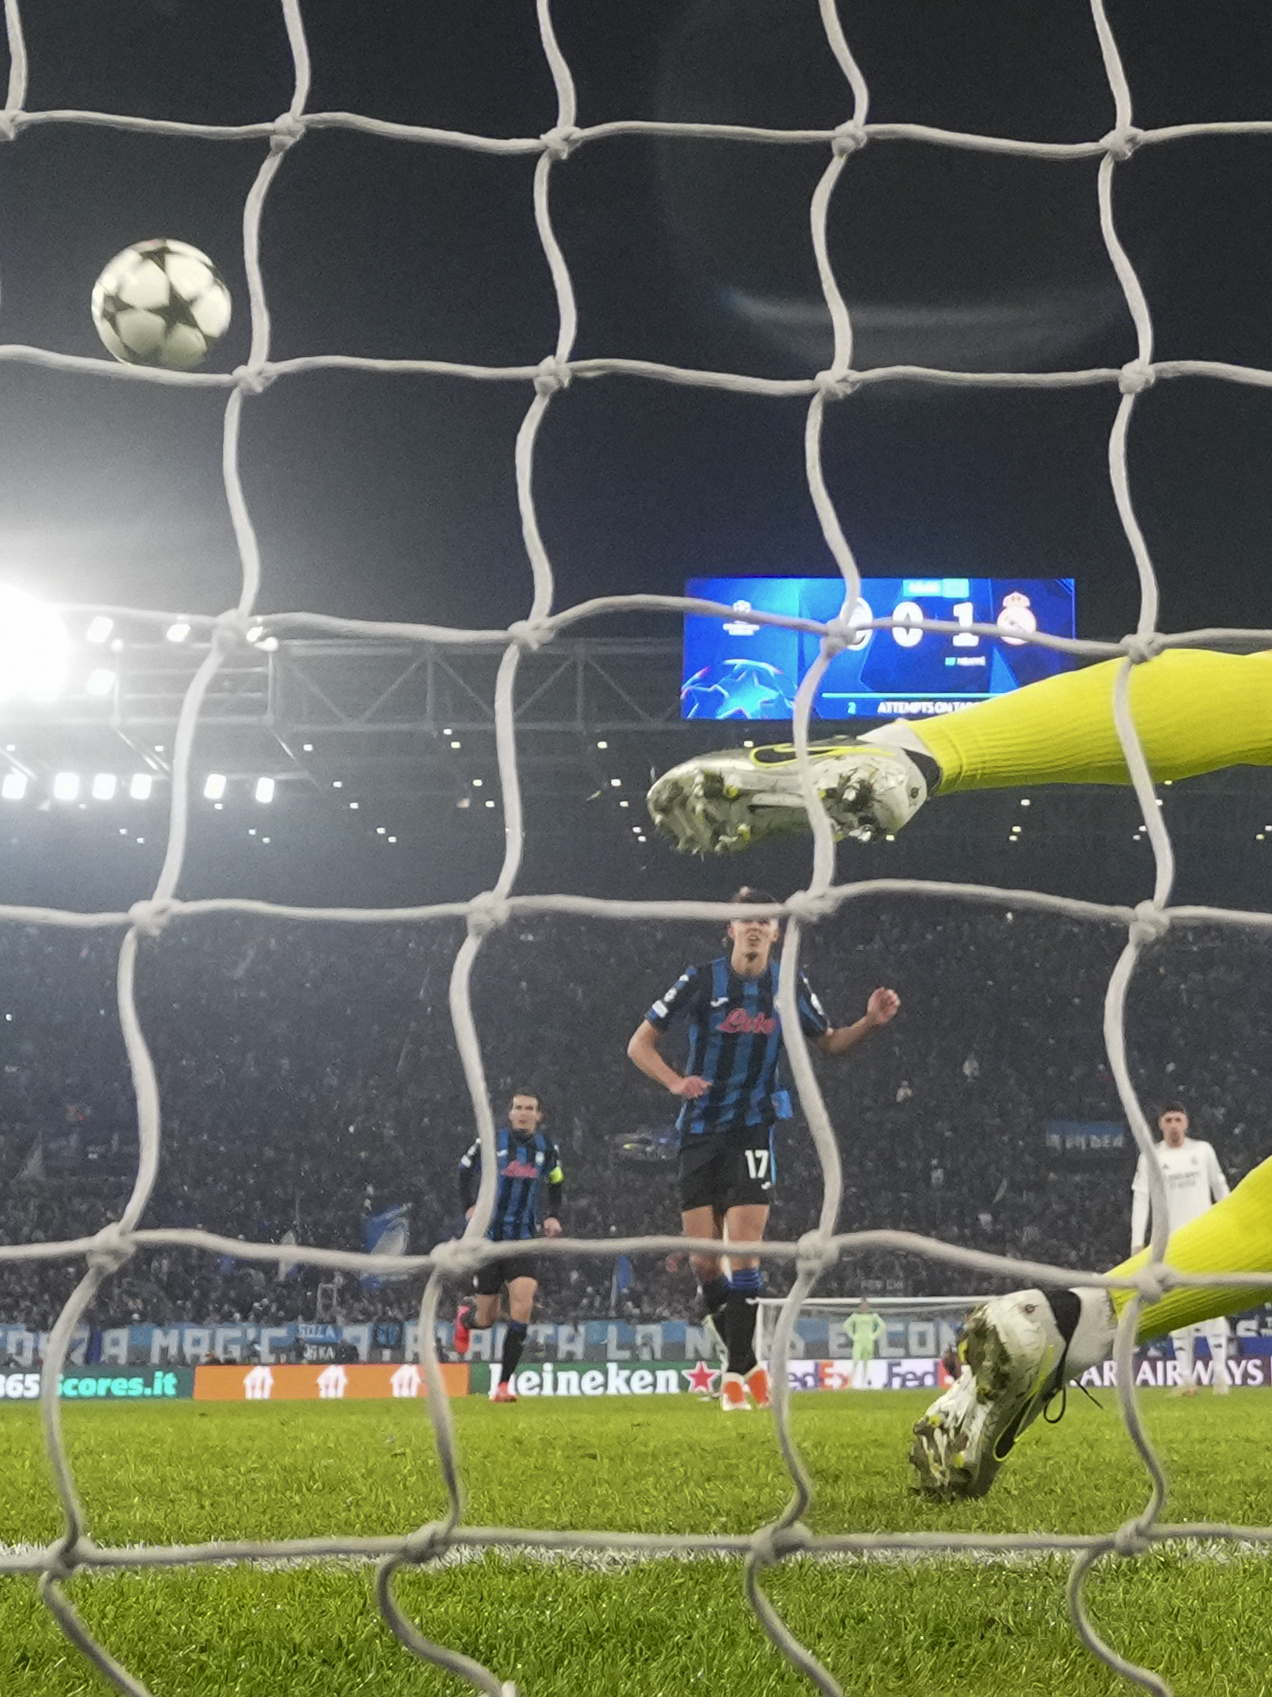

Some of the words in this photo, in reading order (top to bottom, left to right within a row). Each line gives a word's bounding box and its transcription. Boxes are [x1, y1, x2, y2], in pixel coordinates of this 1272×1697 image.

[892, 601, 923, 648] 0
[952, 601, 979, 647] 1
[877, 701, 934, 714] ATTEMPTS
[934, 702, 953, 714] ON
[744, 1149, 769, 1179] 17
[149, 1325, 292, 1365] MAGIC
[776, 1360, 852, 1391] edEx
